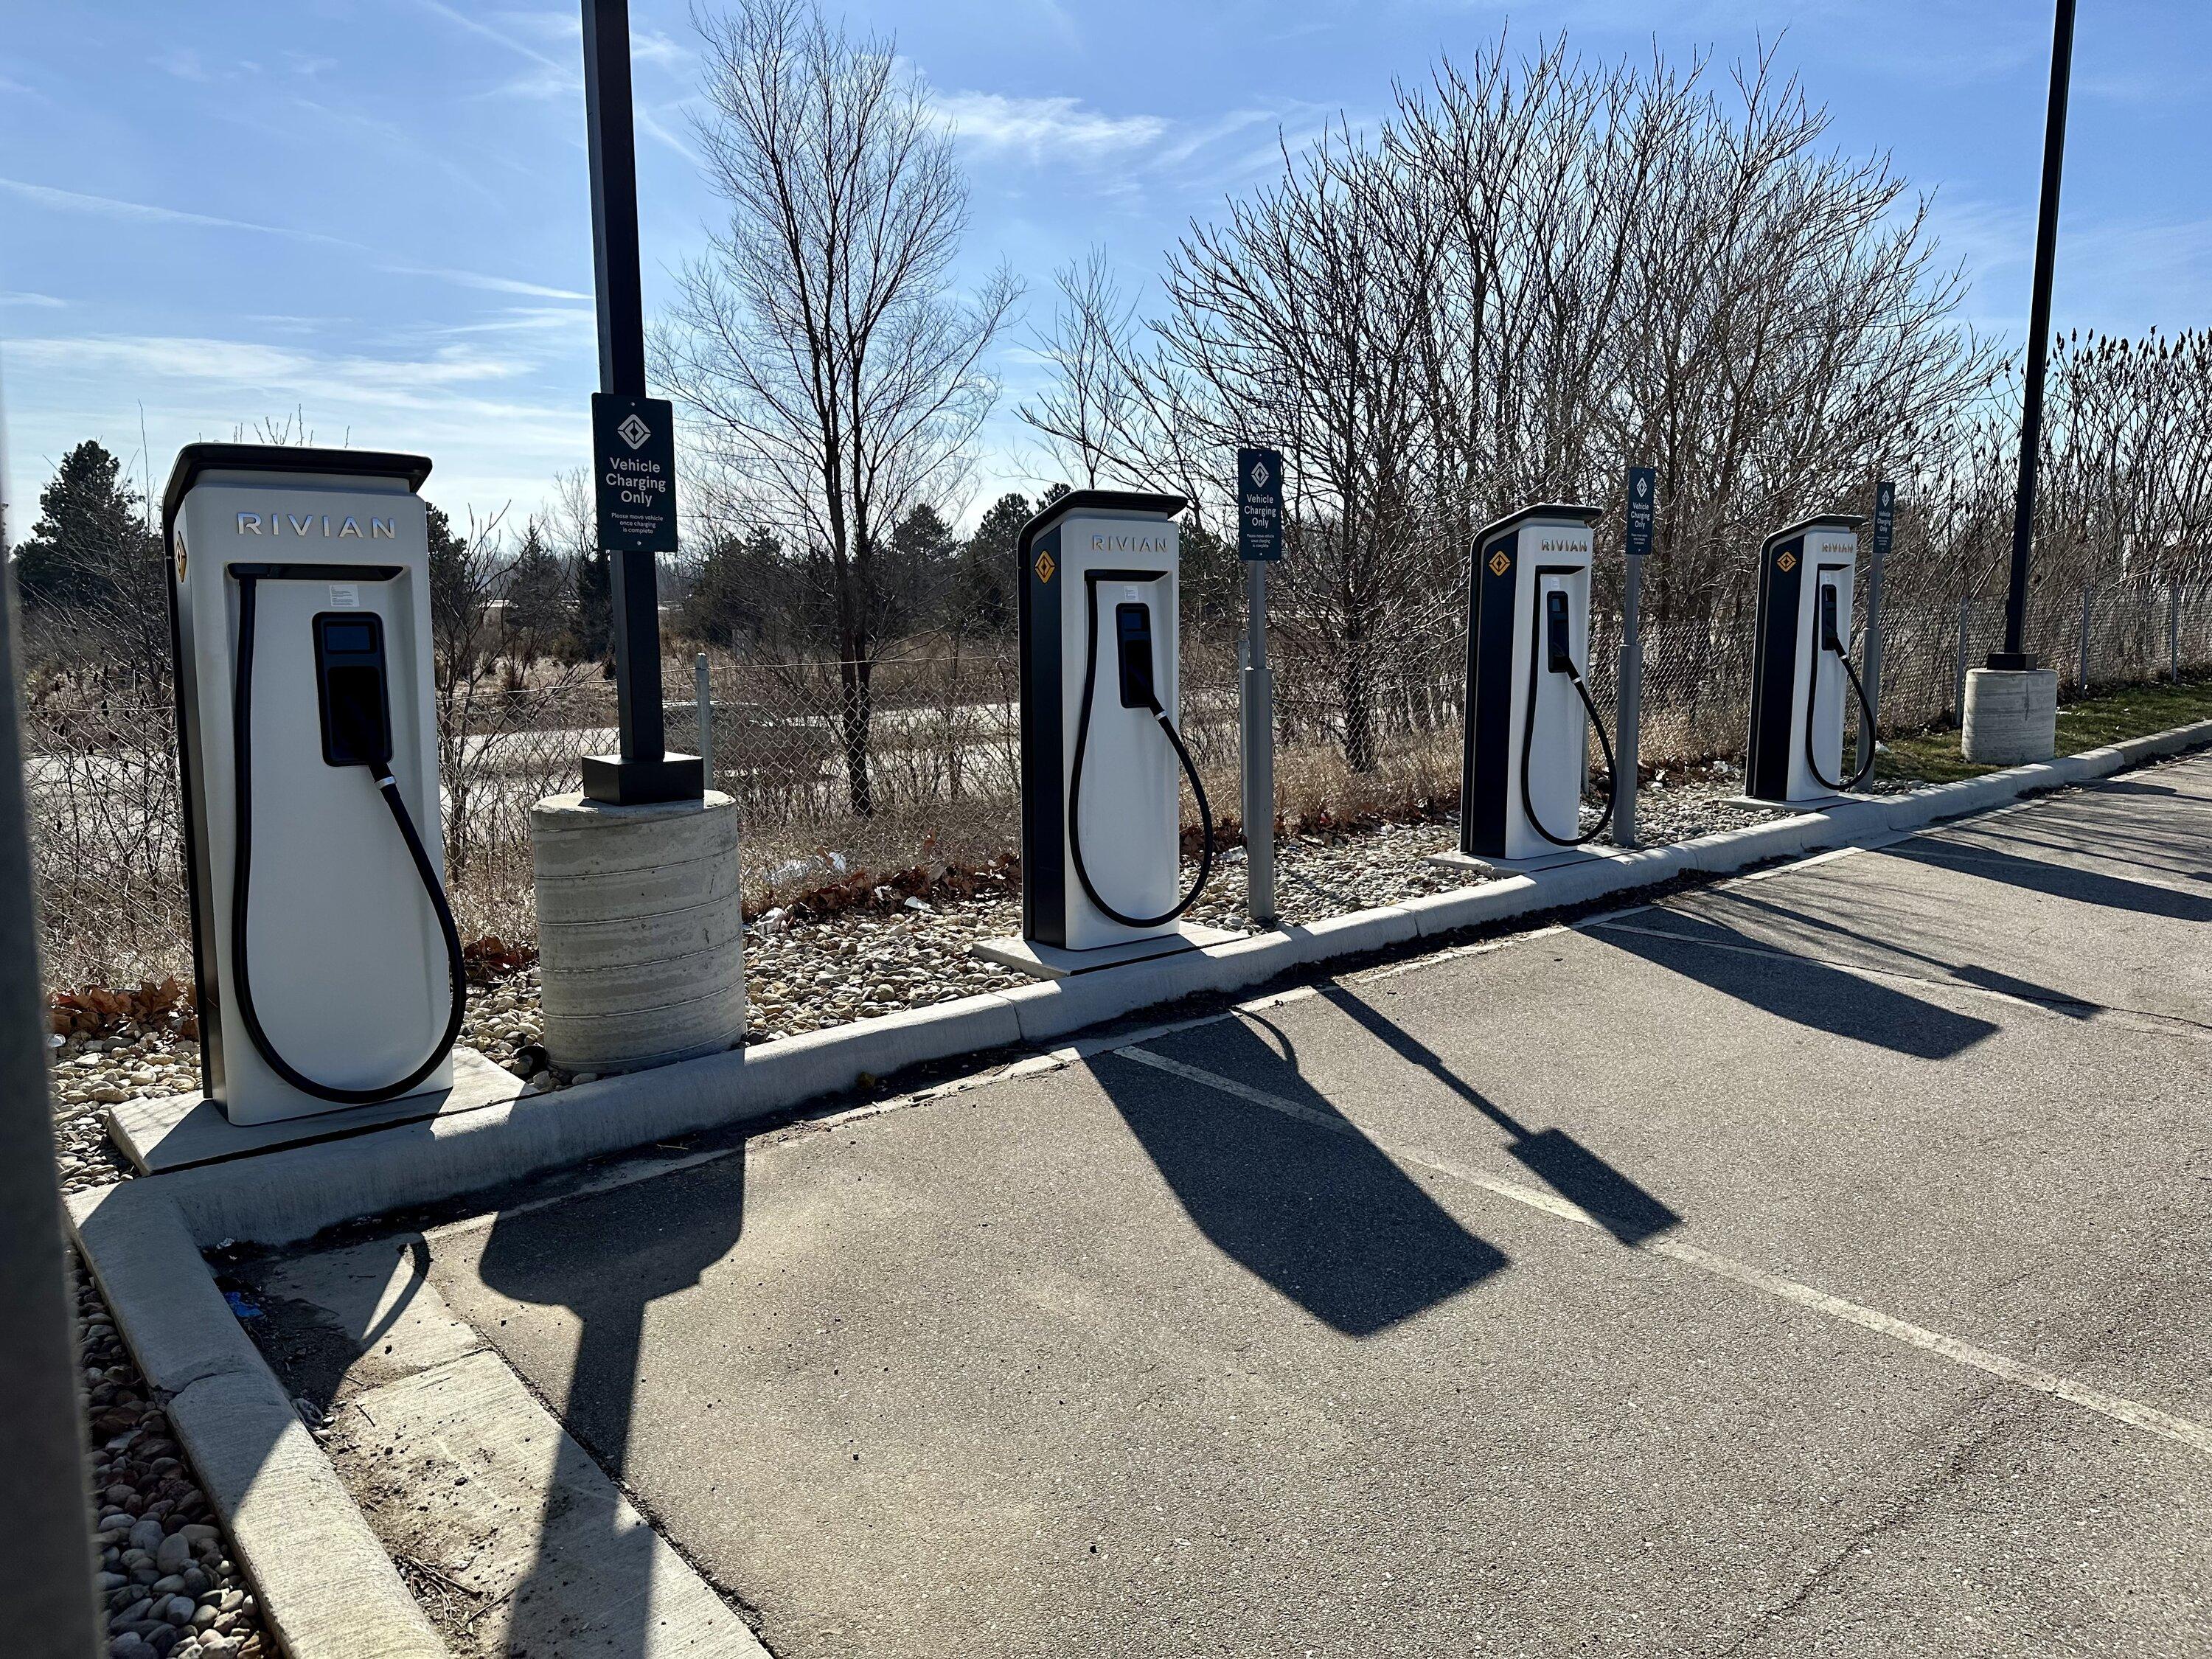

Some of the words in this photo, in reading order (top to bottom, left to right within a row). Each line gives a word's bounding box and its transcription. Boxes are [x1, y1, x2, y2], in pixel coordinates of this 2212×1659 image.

[610, 456, 661, 473] Vehicle
[605, 473, 667, 492] Charging
[621, 490, 653, 507] Only
[1246, 494, 1273, 504] Vehicle
[1244, 506, 1276, 518] Charging
[236, 512, 394, 539] RIVIAN
[633, 521, 656, 529] charging
[1252, 518, 1269, 529] Only
[1635, 520, 1645, 529] Only
[1092, 535, 1168, 552] RIVIAN
[1542, 539, 1587, 552] RIVIAN
